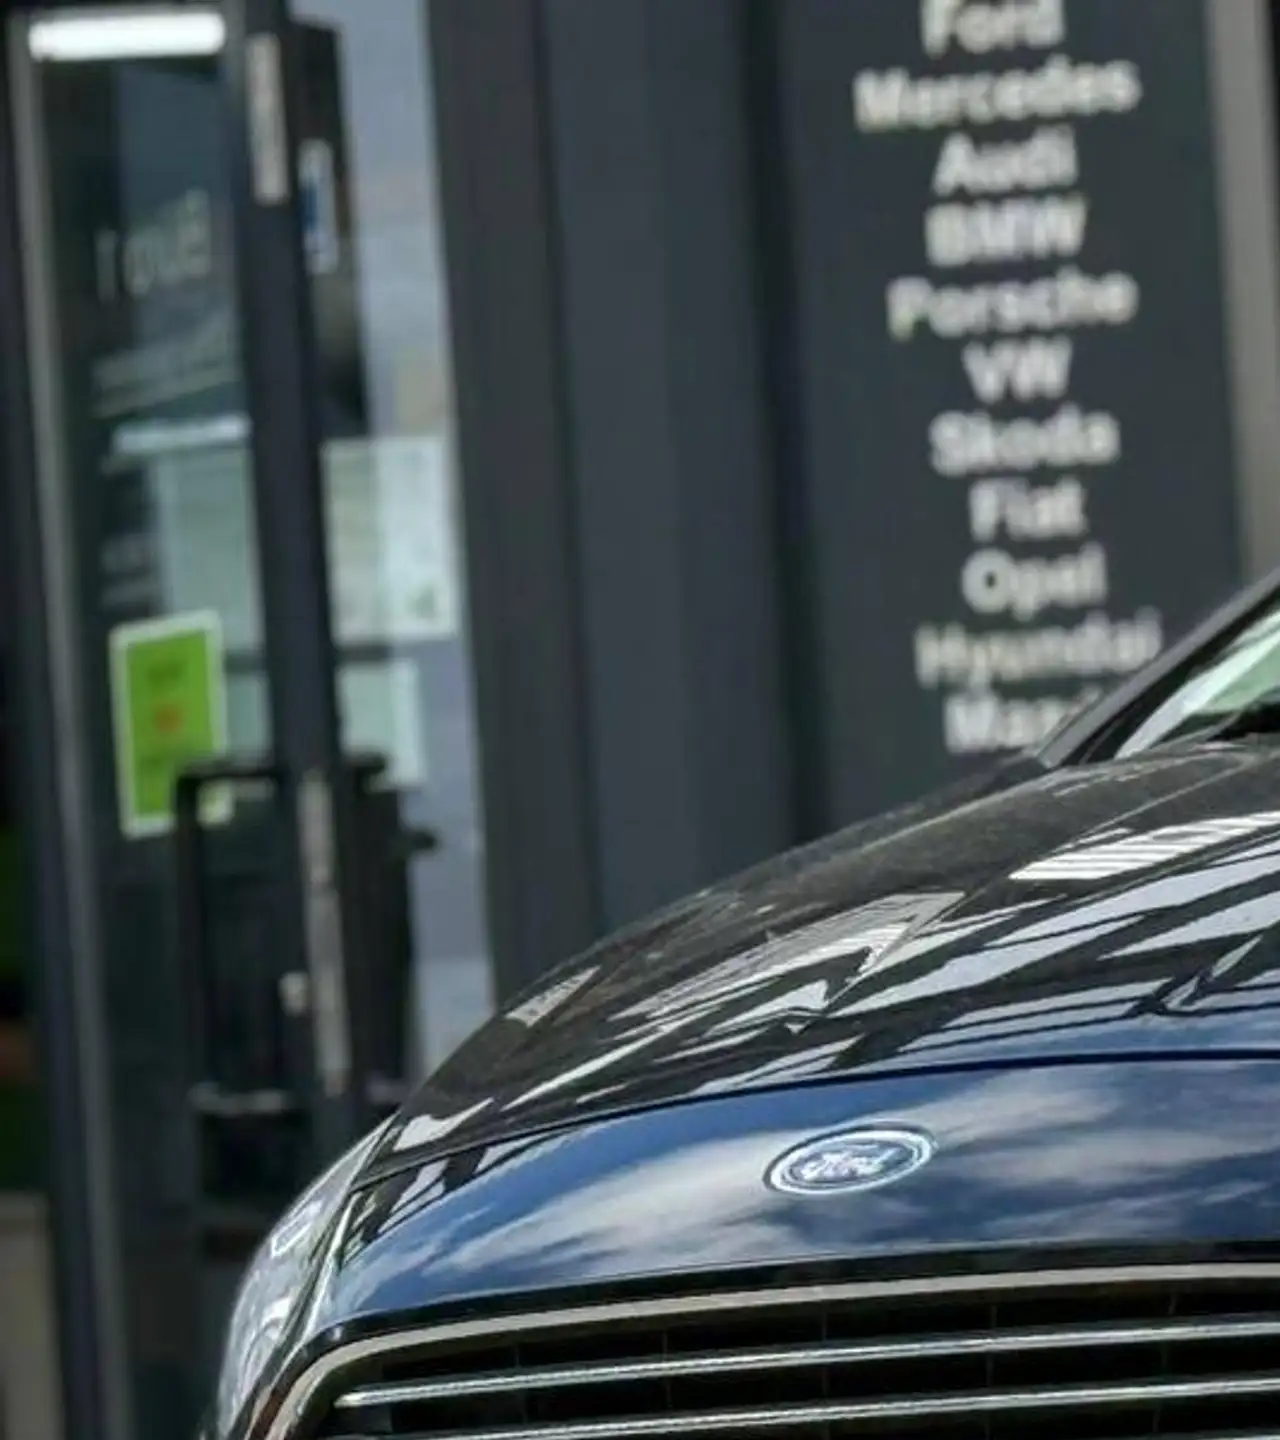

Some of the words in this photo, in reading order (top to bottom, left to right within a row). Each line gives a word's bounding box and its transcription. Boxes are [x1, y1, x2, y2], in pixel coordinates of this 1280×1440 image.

[921, 0, 1065, 56] Ford
[853, 55, 1141, 131] Mercedes
[933, 126, 1078, 196] Audi
[925, 193, 1087, 265] BMW
[887, 265, 1139, 341] Porsche
[961, 337, 1072, 403] VW
[928, 403, 1120, 477] Skoda
[970, 476, 1086, 541] Fiat
[962, 541, 1106, 621] Opel
[914, 606, 1161, 692] Hyundai
